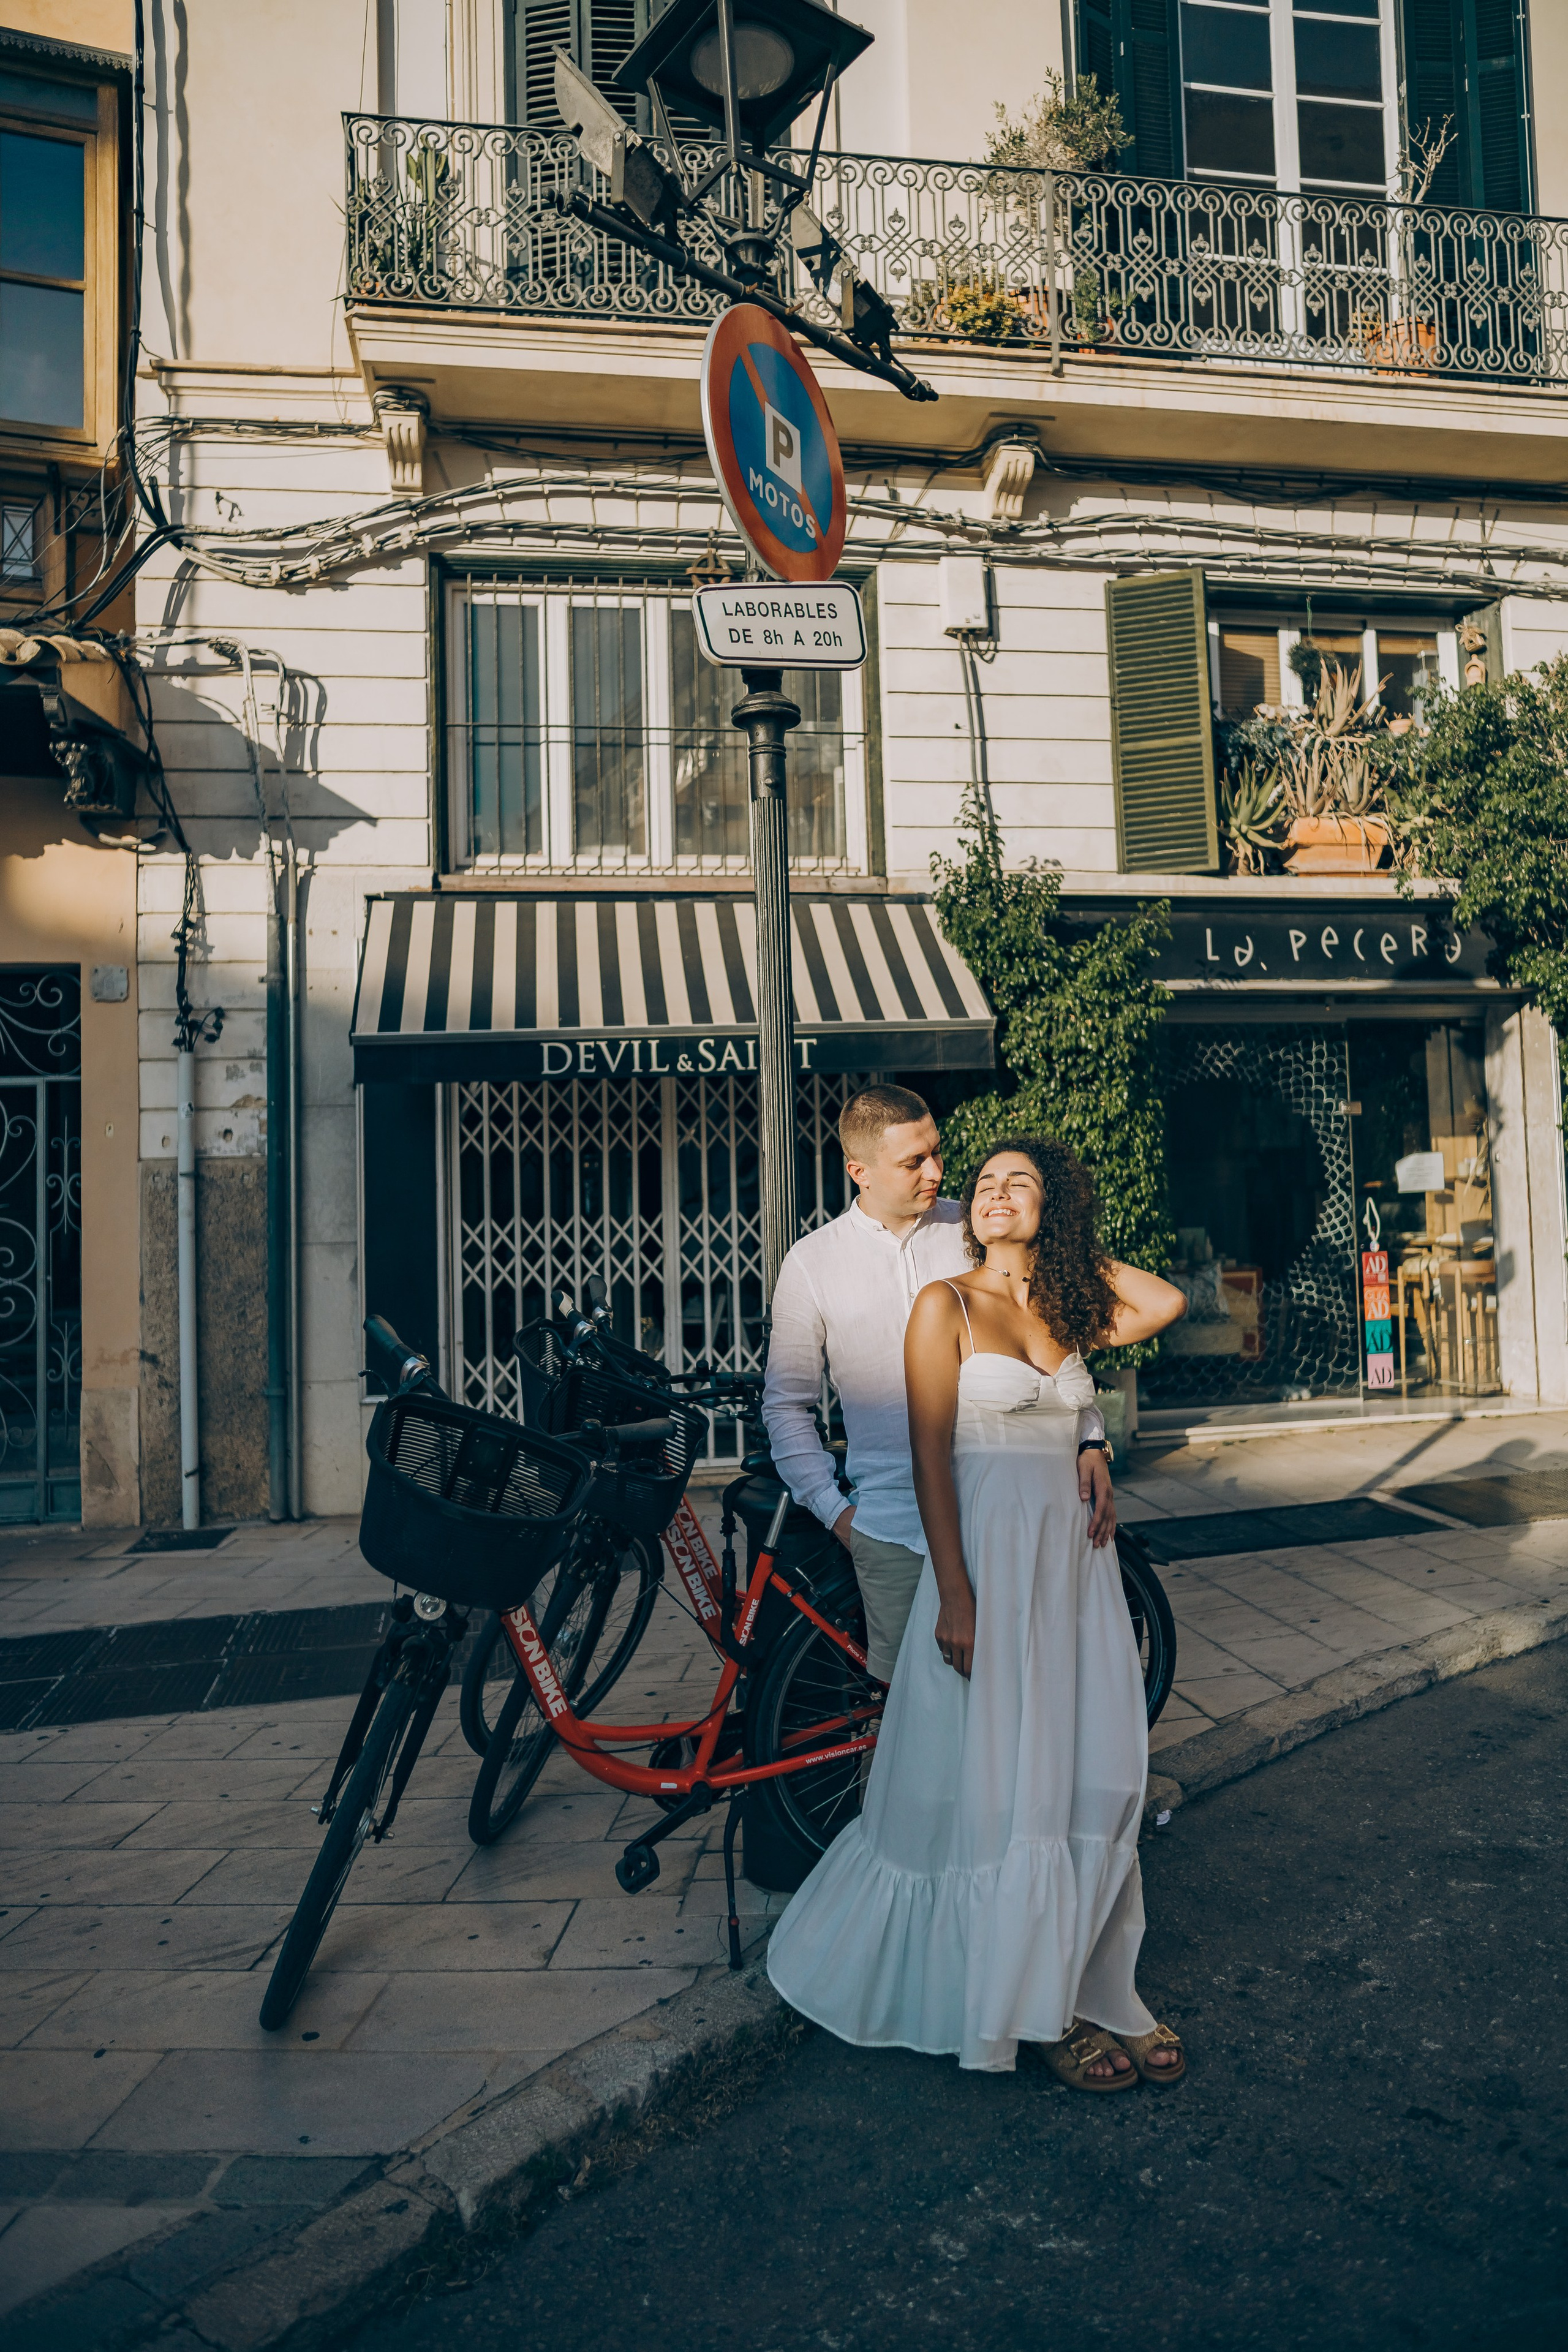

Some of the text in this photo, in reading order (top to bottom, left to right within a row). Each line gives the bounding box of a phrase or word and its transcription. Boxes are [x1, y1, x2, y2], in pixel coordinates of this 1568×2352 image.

[772, 415, 794, 468] P
[749, 466, 816, 539] MOTOS
[722, 601, 838, 619] LABORABLES
[728, 628, 843, 647] DE 8h A 20h
[540, 1039, 670, 1075] DEVIL
[698, 1038, 818, 1072] SAIT
[1365, 1255, 1387, 1275] AD
[1367, 1299, 1390, 1320] AD
[1366, 1330, 1393, 1352] AD
[1371, 1366, 1392, 1384] AD
[689, 1535, 718, 1580] BIKE
[685, 1571, 717, 1621] BIKE
[746, 1598, 760, 1622] BIKE
[532, 1659, 568, 1718] BIKE
[805, 1744, 867, 1765] www.visioncar.es
